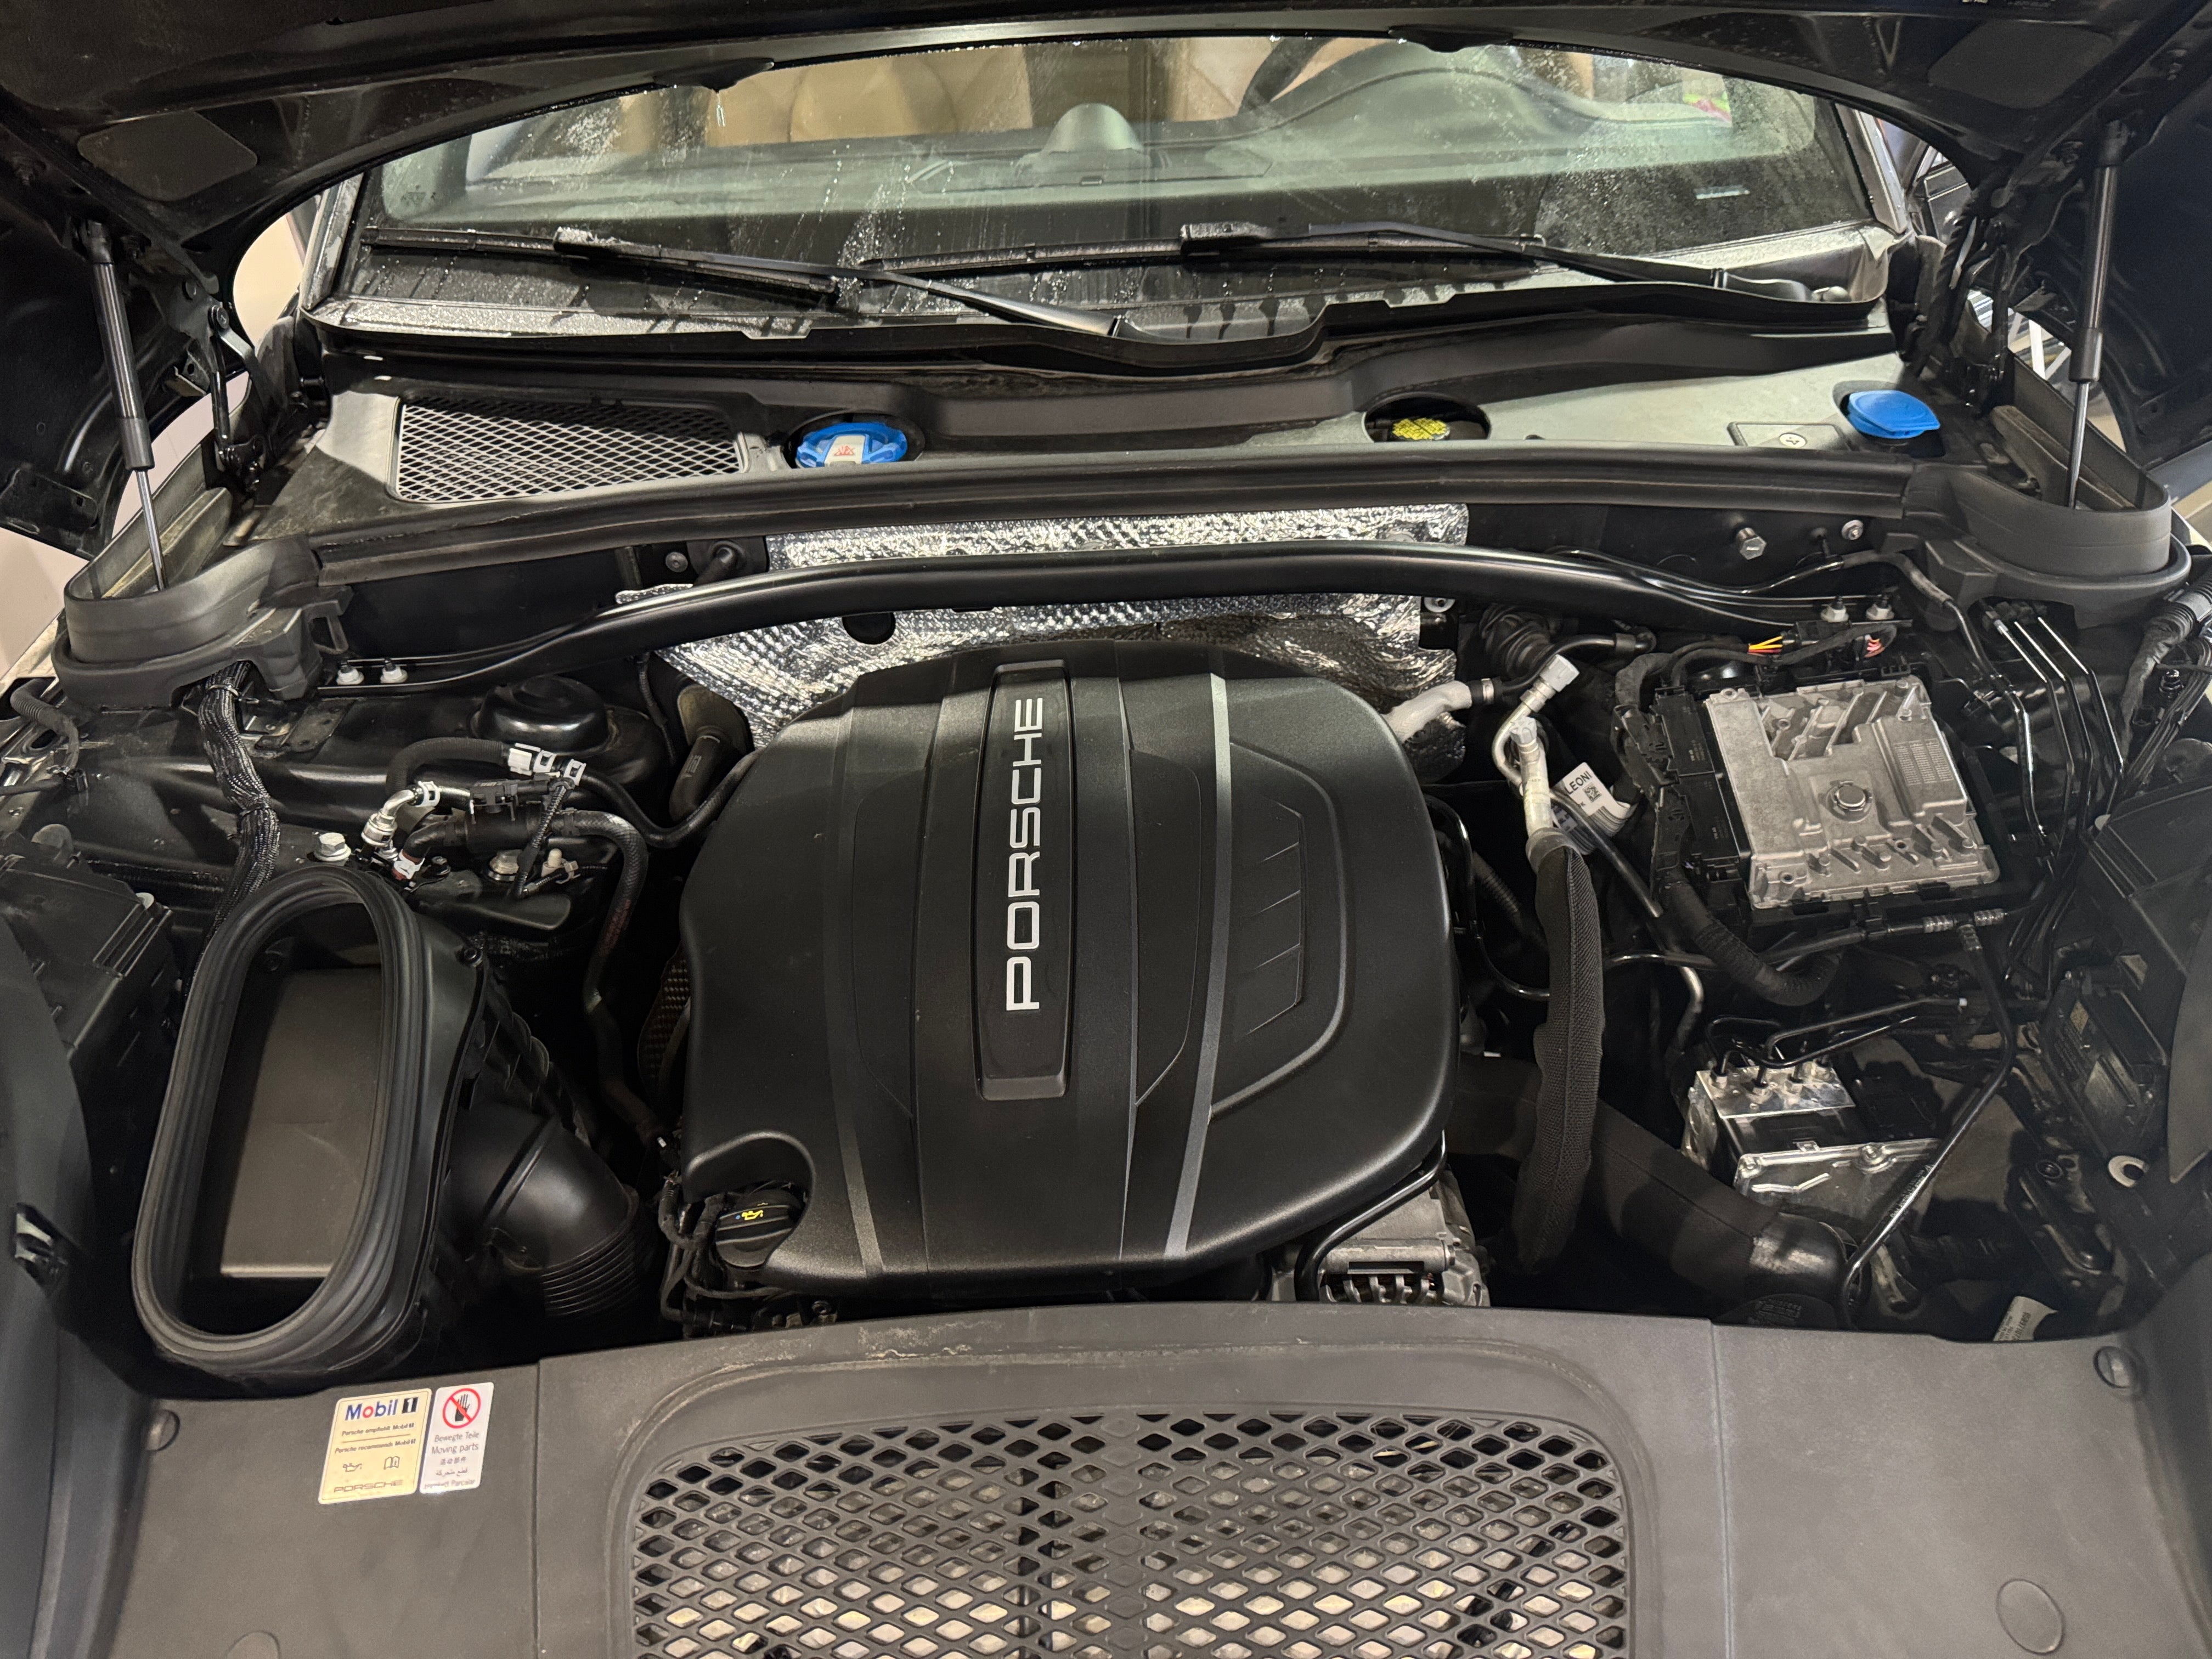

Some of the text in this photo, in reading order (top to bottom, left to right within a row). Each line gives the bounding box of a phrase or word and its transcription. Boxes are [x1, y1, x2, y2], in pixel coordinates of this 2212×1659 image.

[1564, 770, 1592, 795] LEONI
[1006, 697, 1043, 1011] PORSCHE
[345, 1399, 398, 1421] Mobil
[435, 1431, 479, 1442] Bewegte Teile
[335, 1446, 357, 1454] Porsche
[432, 1443, 479, 1454] Moving parts
[334, 1480, 403, 1493] PORSCHE
